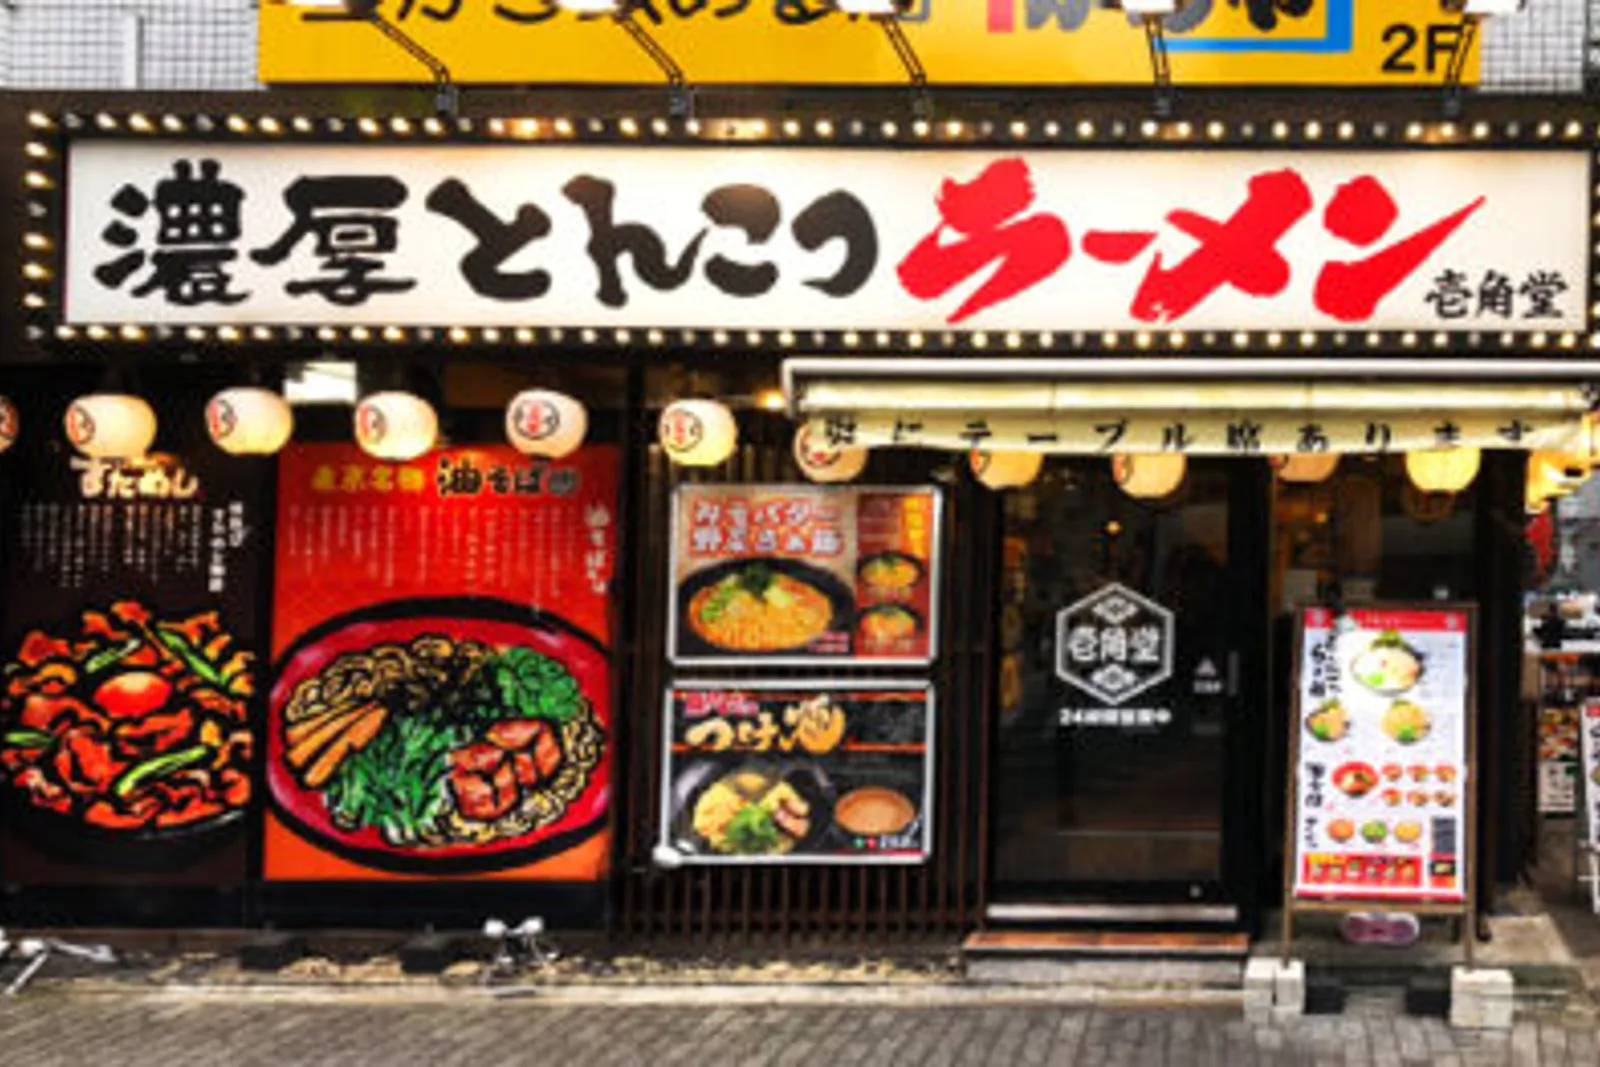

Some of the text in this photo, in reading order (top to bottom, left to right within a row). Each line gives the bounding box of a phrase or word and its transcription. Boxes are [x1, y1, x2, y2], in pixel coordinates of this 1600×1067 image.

[1381, 24, 1463, 72] 2F
[93, 158, 1486, 323] 濃厚とんこつラーメン
[1424, 268, 1569, 319] 壱角堂
